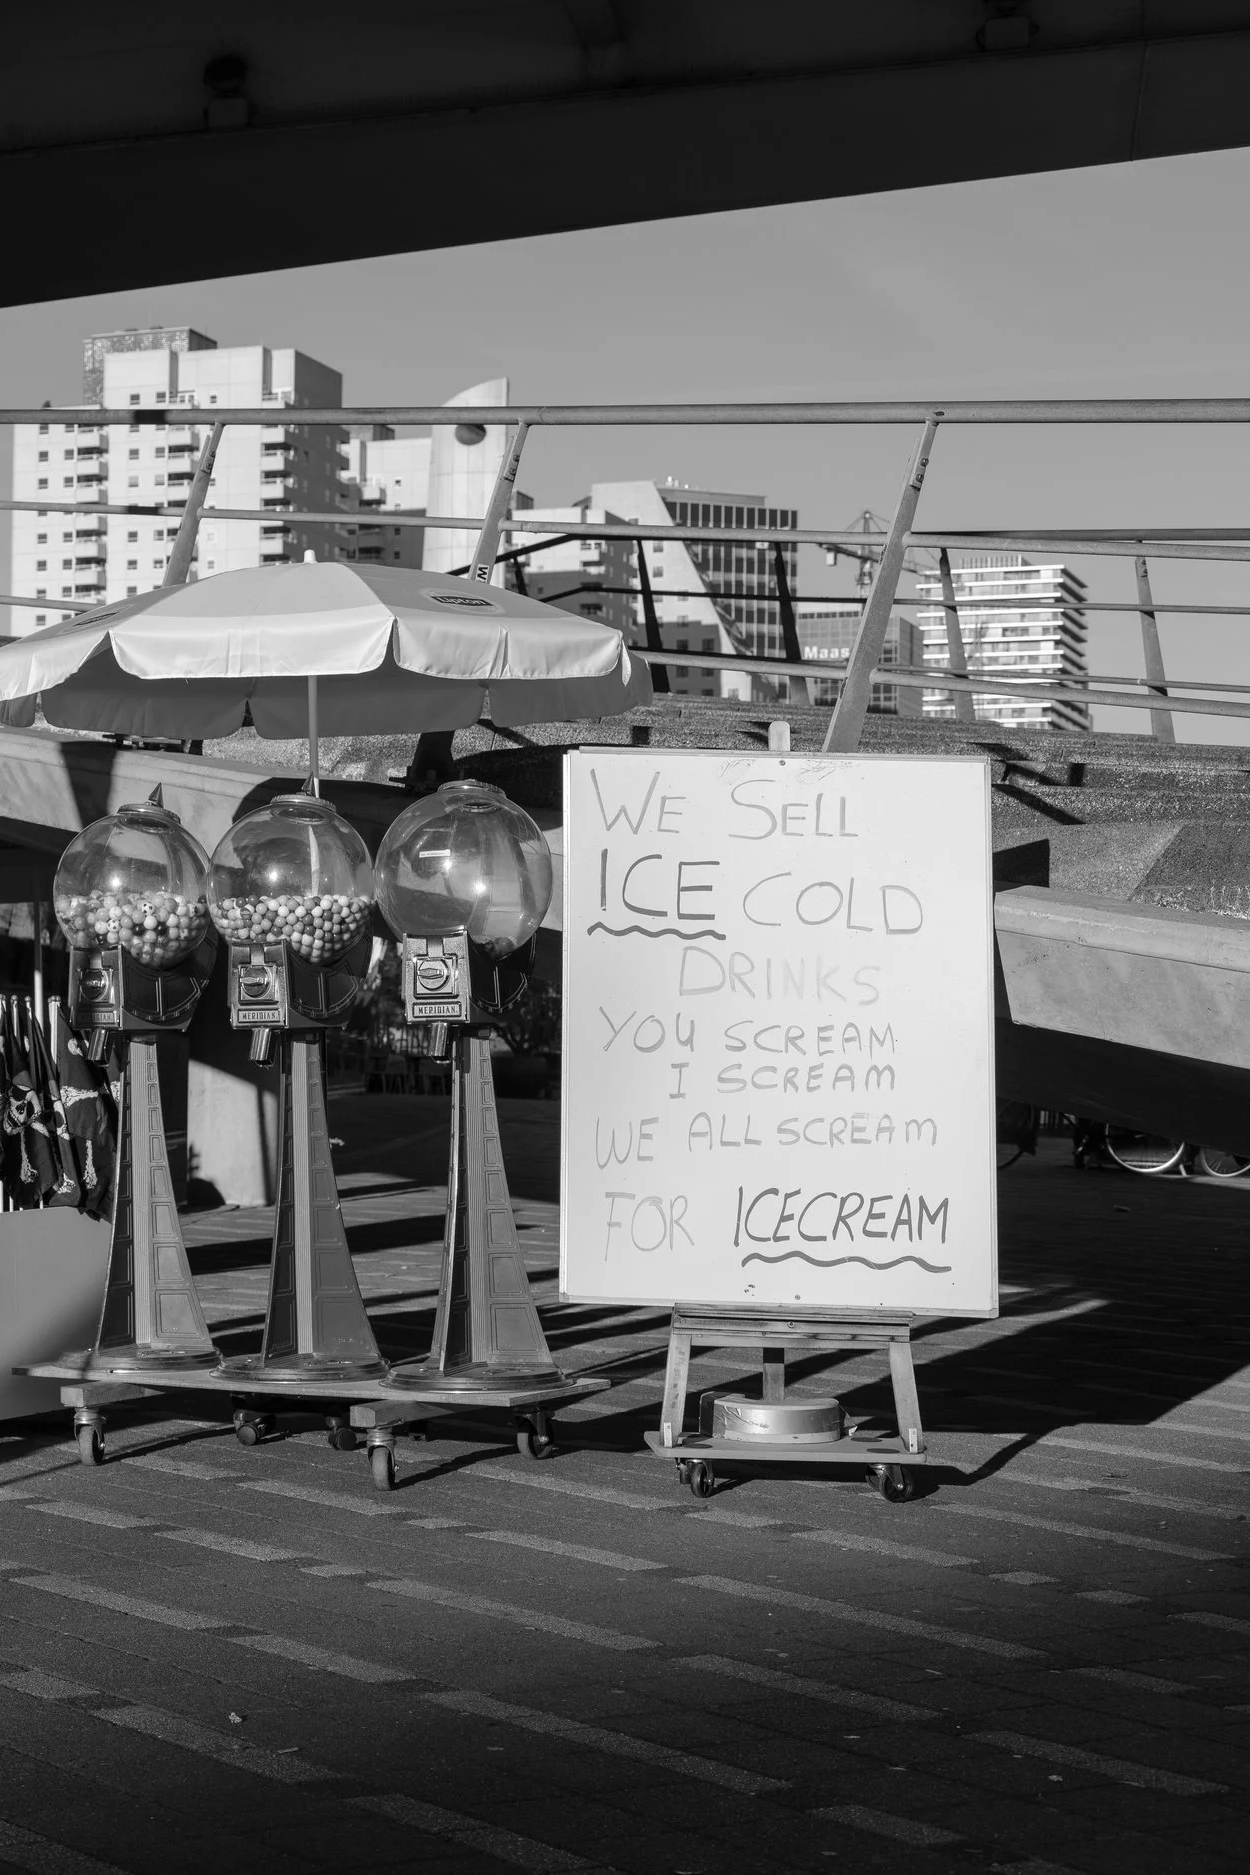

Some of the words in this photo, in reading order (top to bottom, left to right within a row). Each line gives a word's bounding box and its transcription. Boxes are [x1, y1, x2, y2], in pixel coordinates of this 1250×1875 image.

[436, 596, 486, 605] Lipton
[803, 645, 851, 660] Maas
[590, 768, 687, 836] WE
[728, 779, 859, 840] SELL
[600, 848, 720, 921] ICE
[743, 872, 924, 936] COLD
[679, 946, 881, 1005] DRINKS
[242, 1011, 277, 1020] MERIDIAN
[418, 1005, 456, 1015] MERIDIAN
[599, 1006, 696, 1053] YOU
[724, 1020, 895, 1061] SCREAM
[668, 1062, 690, 1100] I
[716, 1062, 896, 1094] SCREAM
[595, 1116, 659, 1170] WE
[688, 1111, 763, 1152] ALL
[776, 1116, 938, 1148] SCREAM
[604, 1191, 695, 1262] FOR
[733, 1185, 950, 1248] ICECREAM
